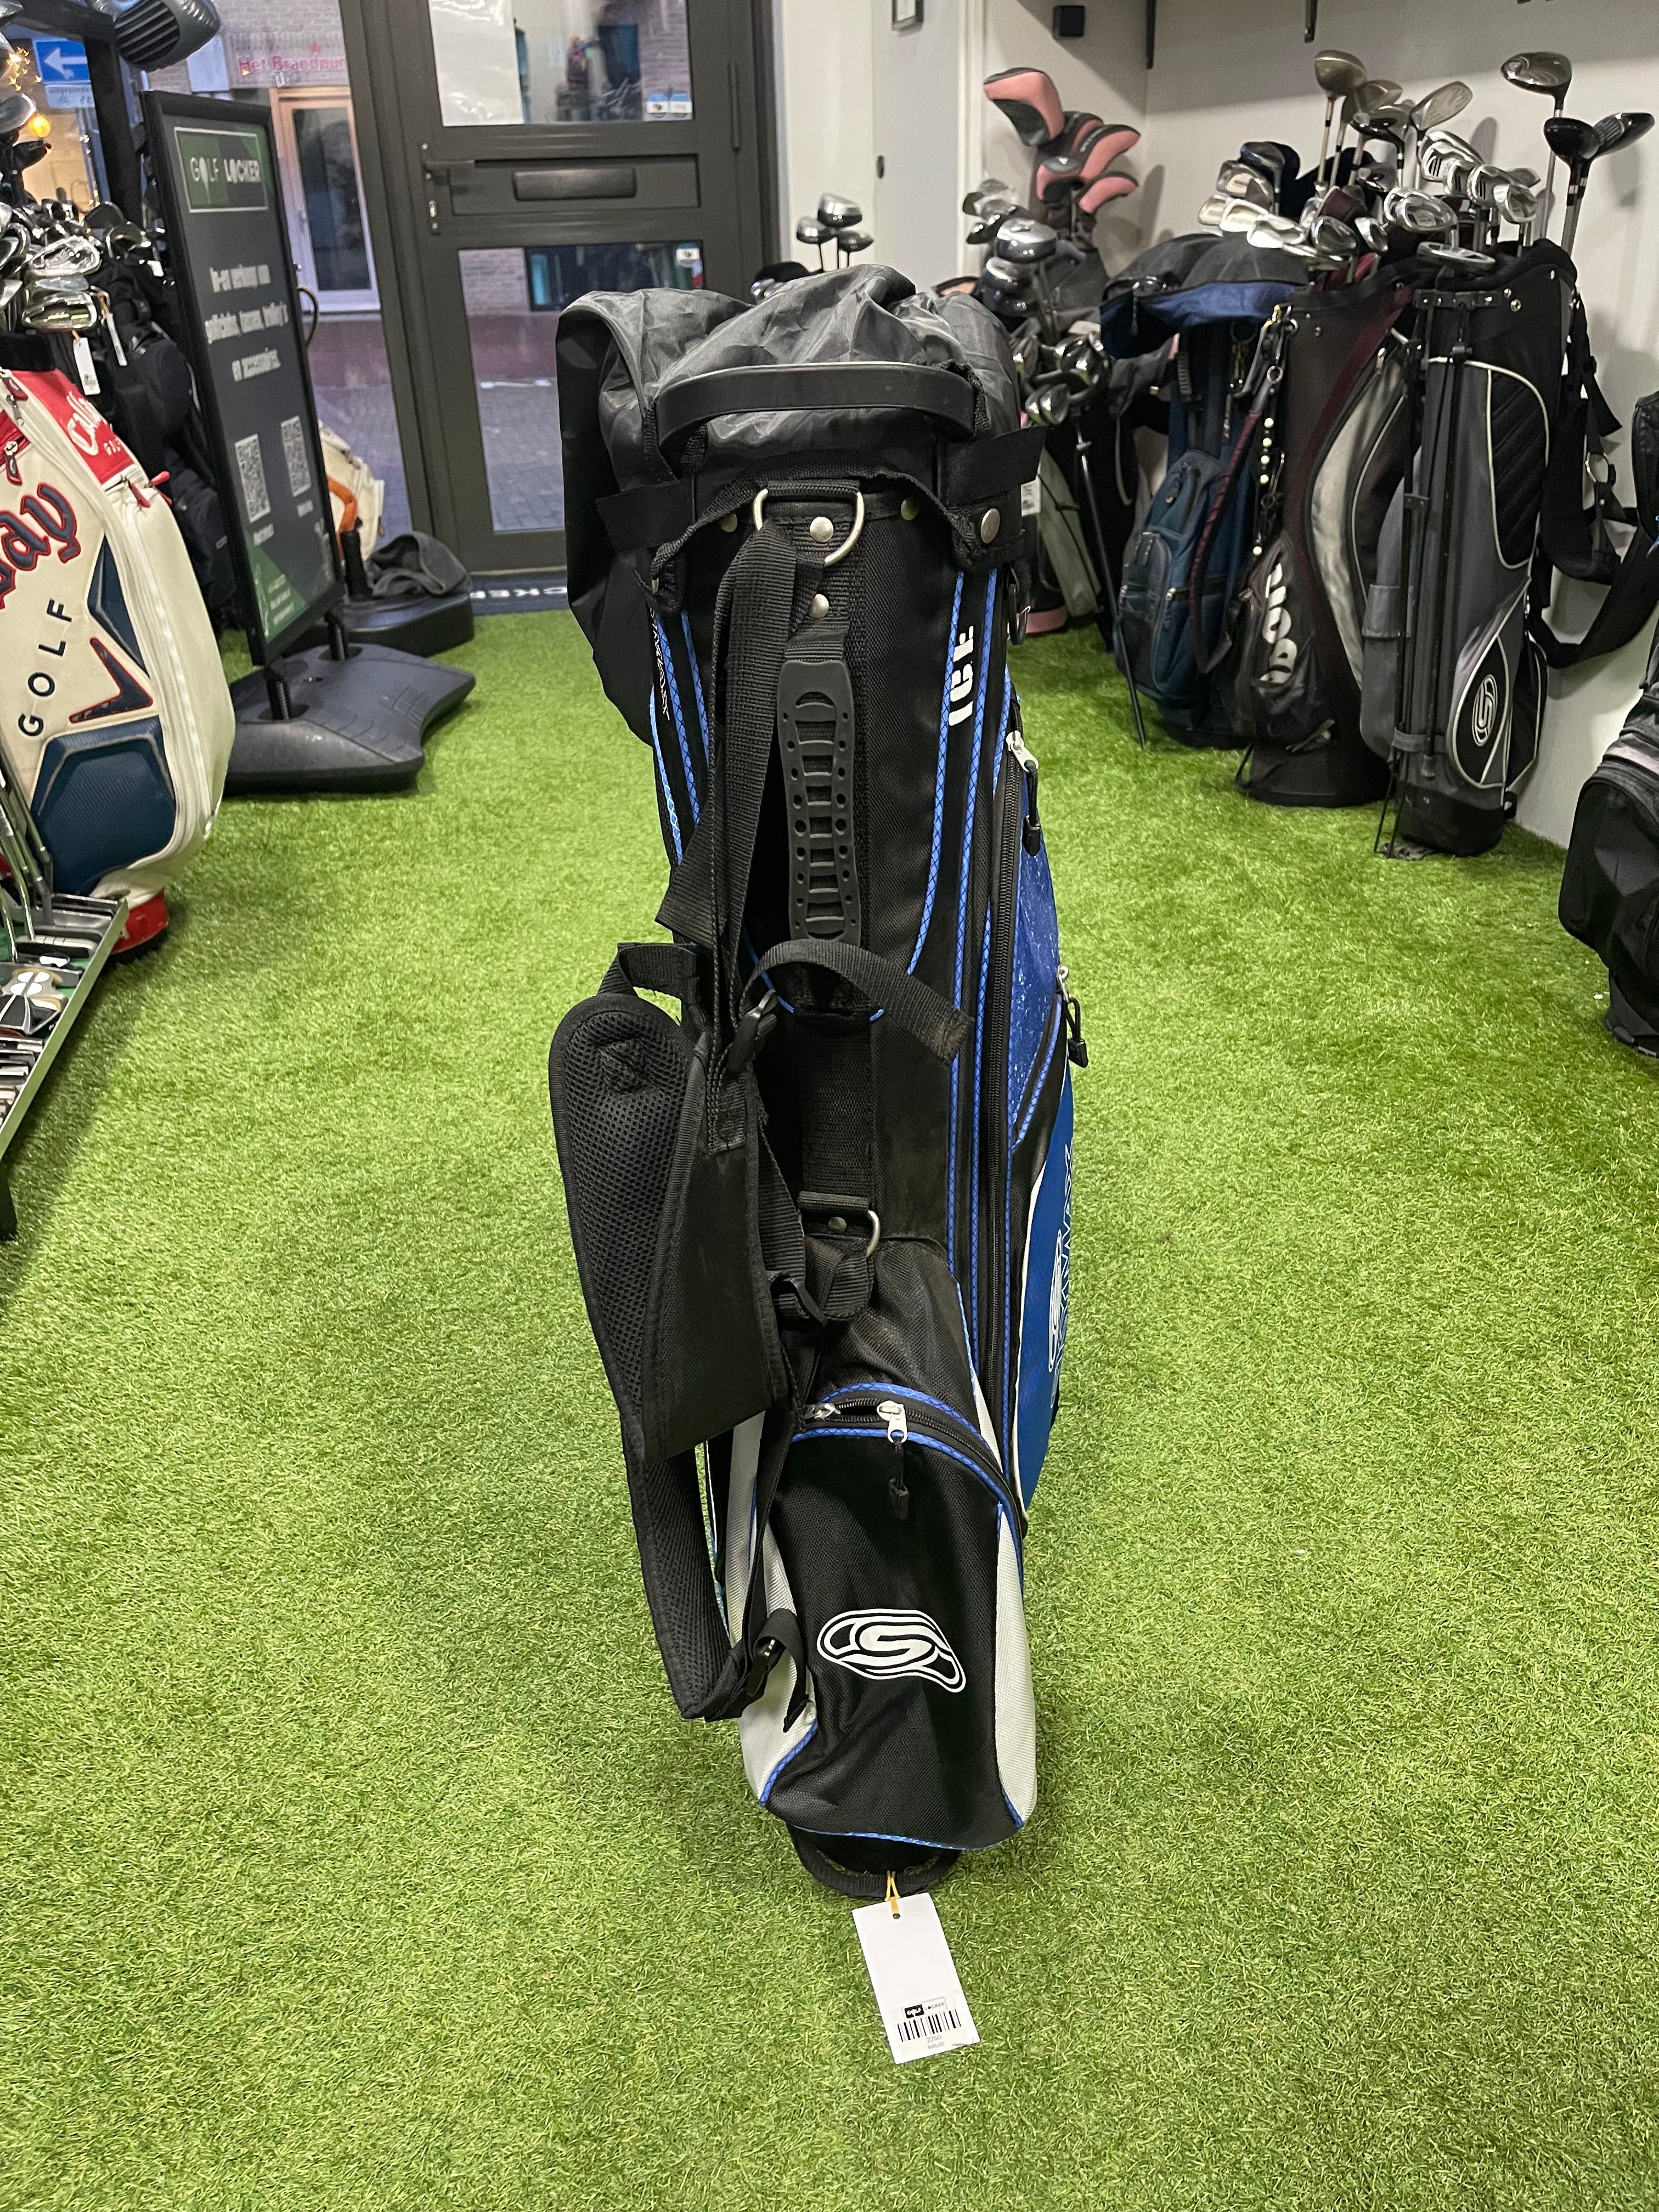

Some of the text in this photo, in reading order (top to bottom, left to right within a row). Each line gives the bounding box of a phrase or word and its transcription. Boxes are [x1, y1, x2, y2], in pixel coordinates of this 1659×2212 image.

[237, 55, 346, 74] Het Brandpun
[18, 598, 72, 737] GOLF
[948, 625, 974, 726] ICE
